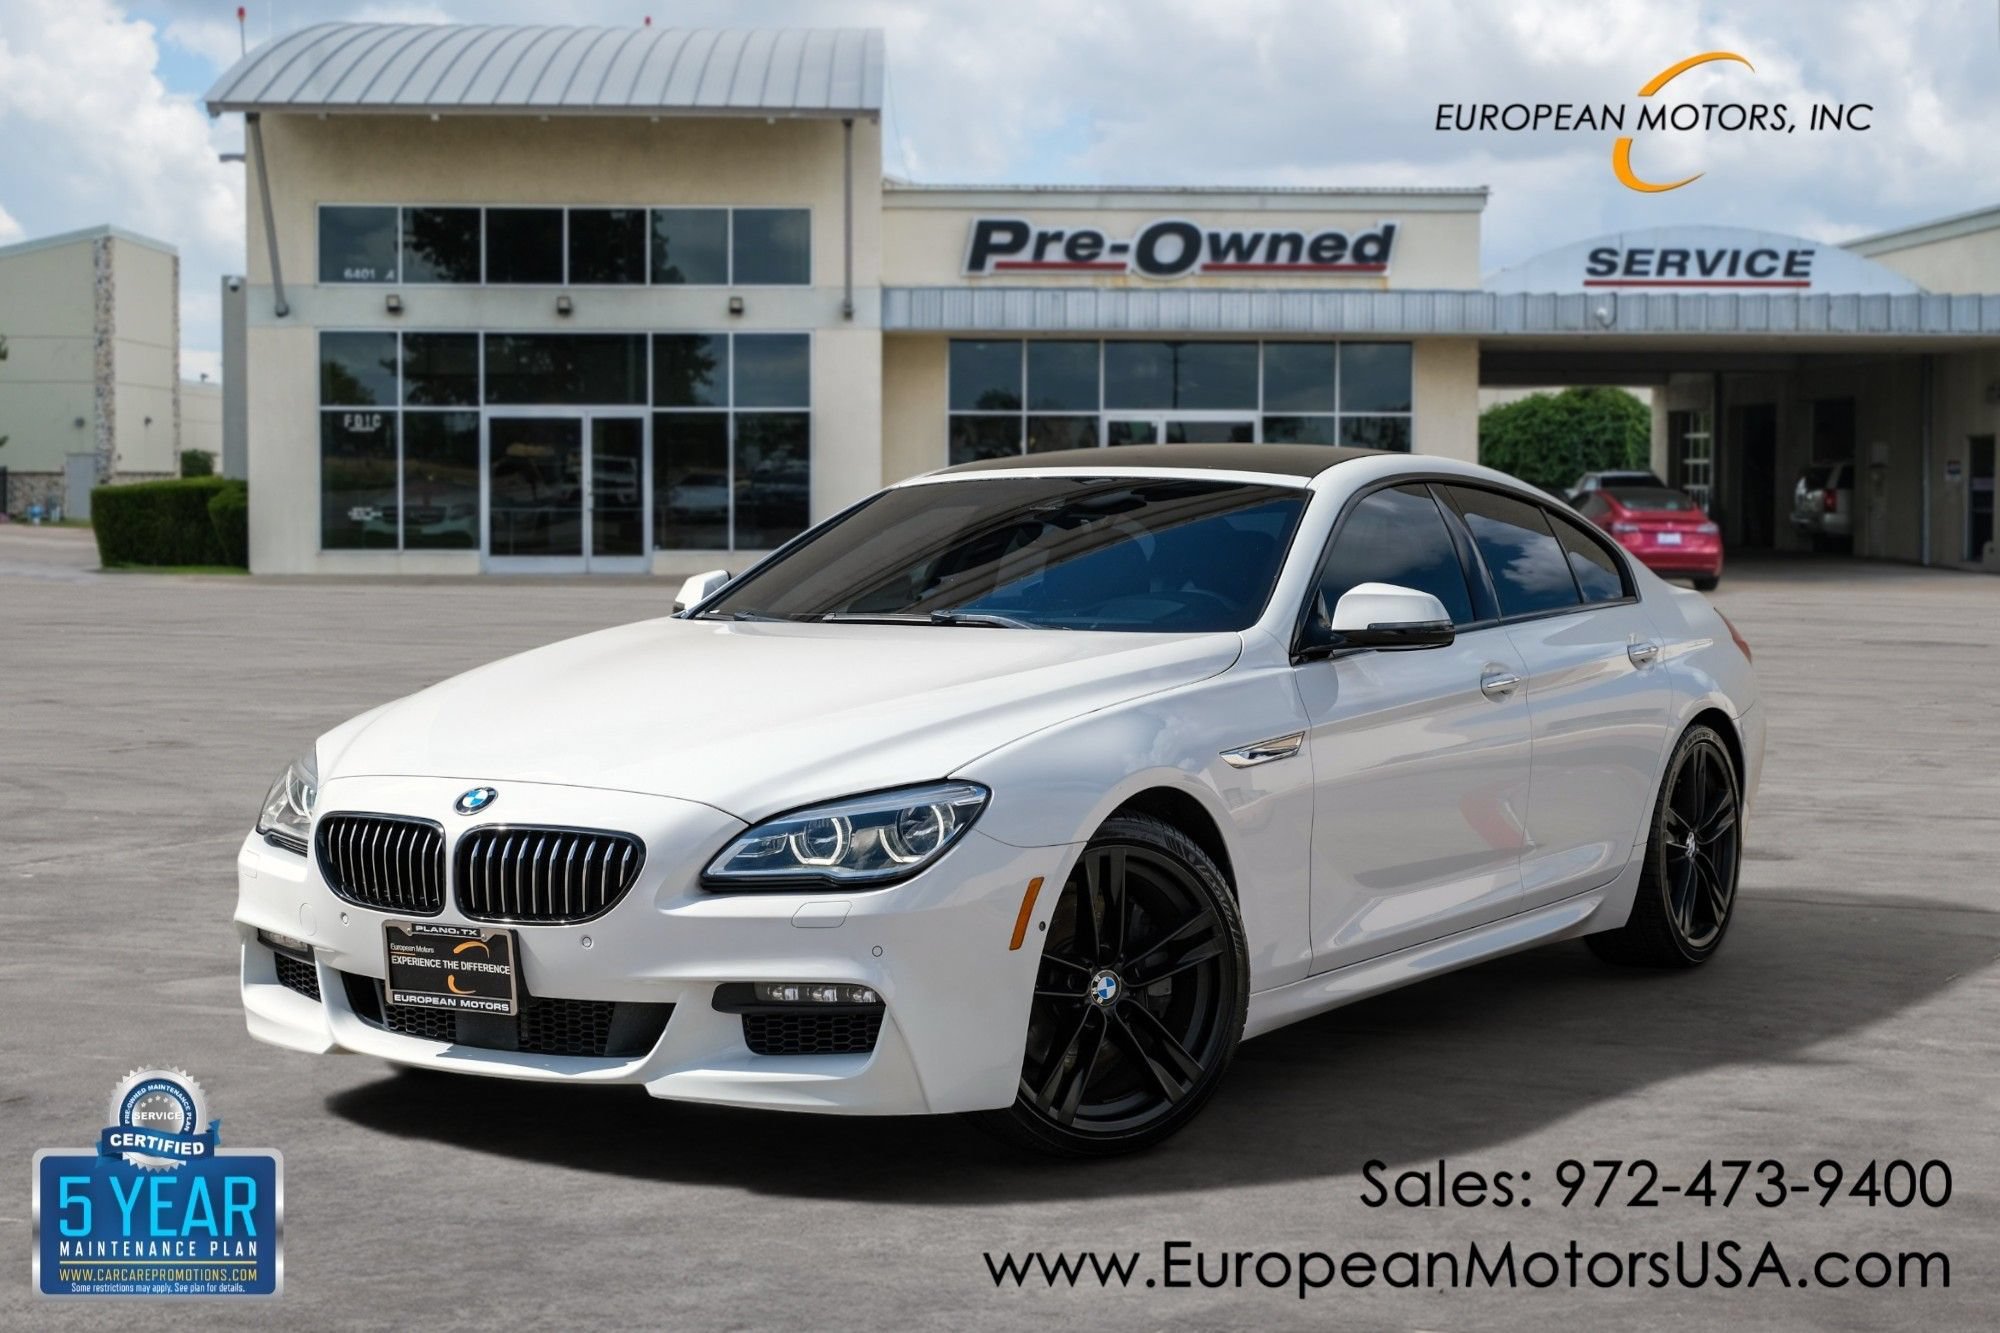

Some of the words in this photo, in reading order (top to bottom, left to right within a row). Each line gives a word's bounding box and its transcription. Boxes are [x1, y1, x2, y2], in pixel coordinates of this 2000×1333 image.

[966, 219, 1397, 276] Pre-Owned
[1585, 247, 1816, 278] SERVICE
[461, 928, 478, 936] TX
[390, 942, 416, 952] European
[416, 945, 435, 954] Motors
[391, 955, 442, 969] EXPERIENCE
[443, 960, 460, 970] THE
[460, 960, 511, 975] DIFFERENCE
[393, 993, 457, 1007] EUROPEAN
[459, 1000, 510, 1012] MOTORS
